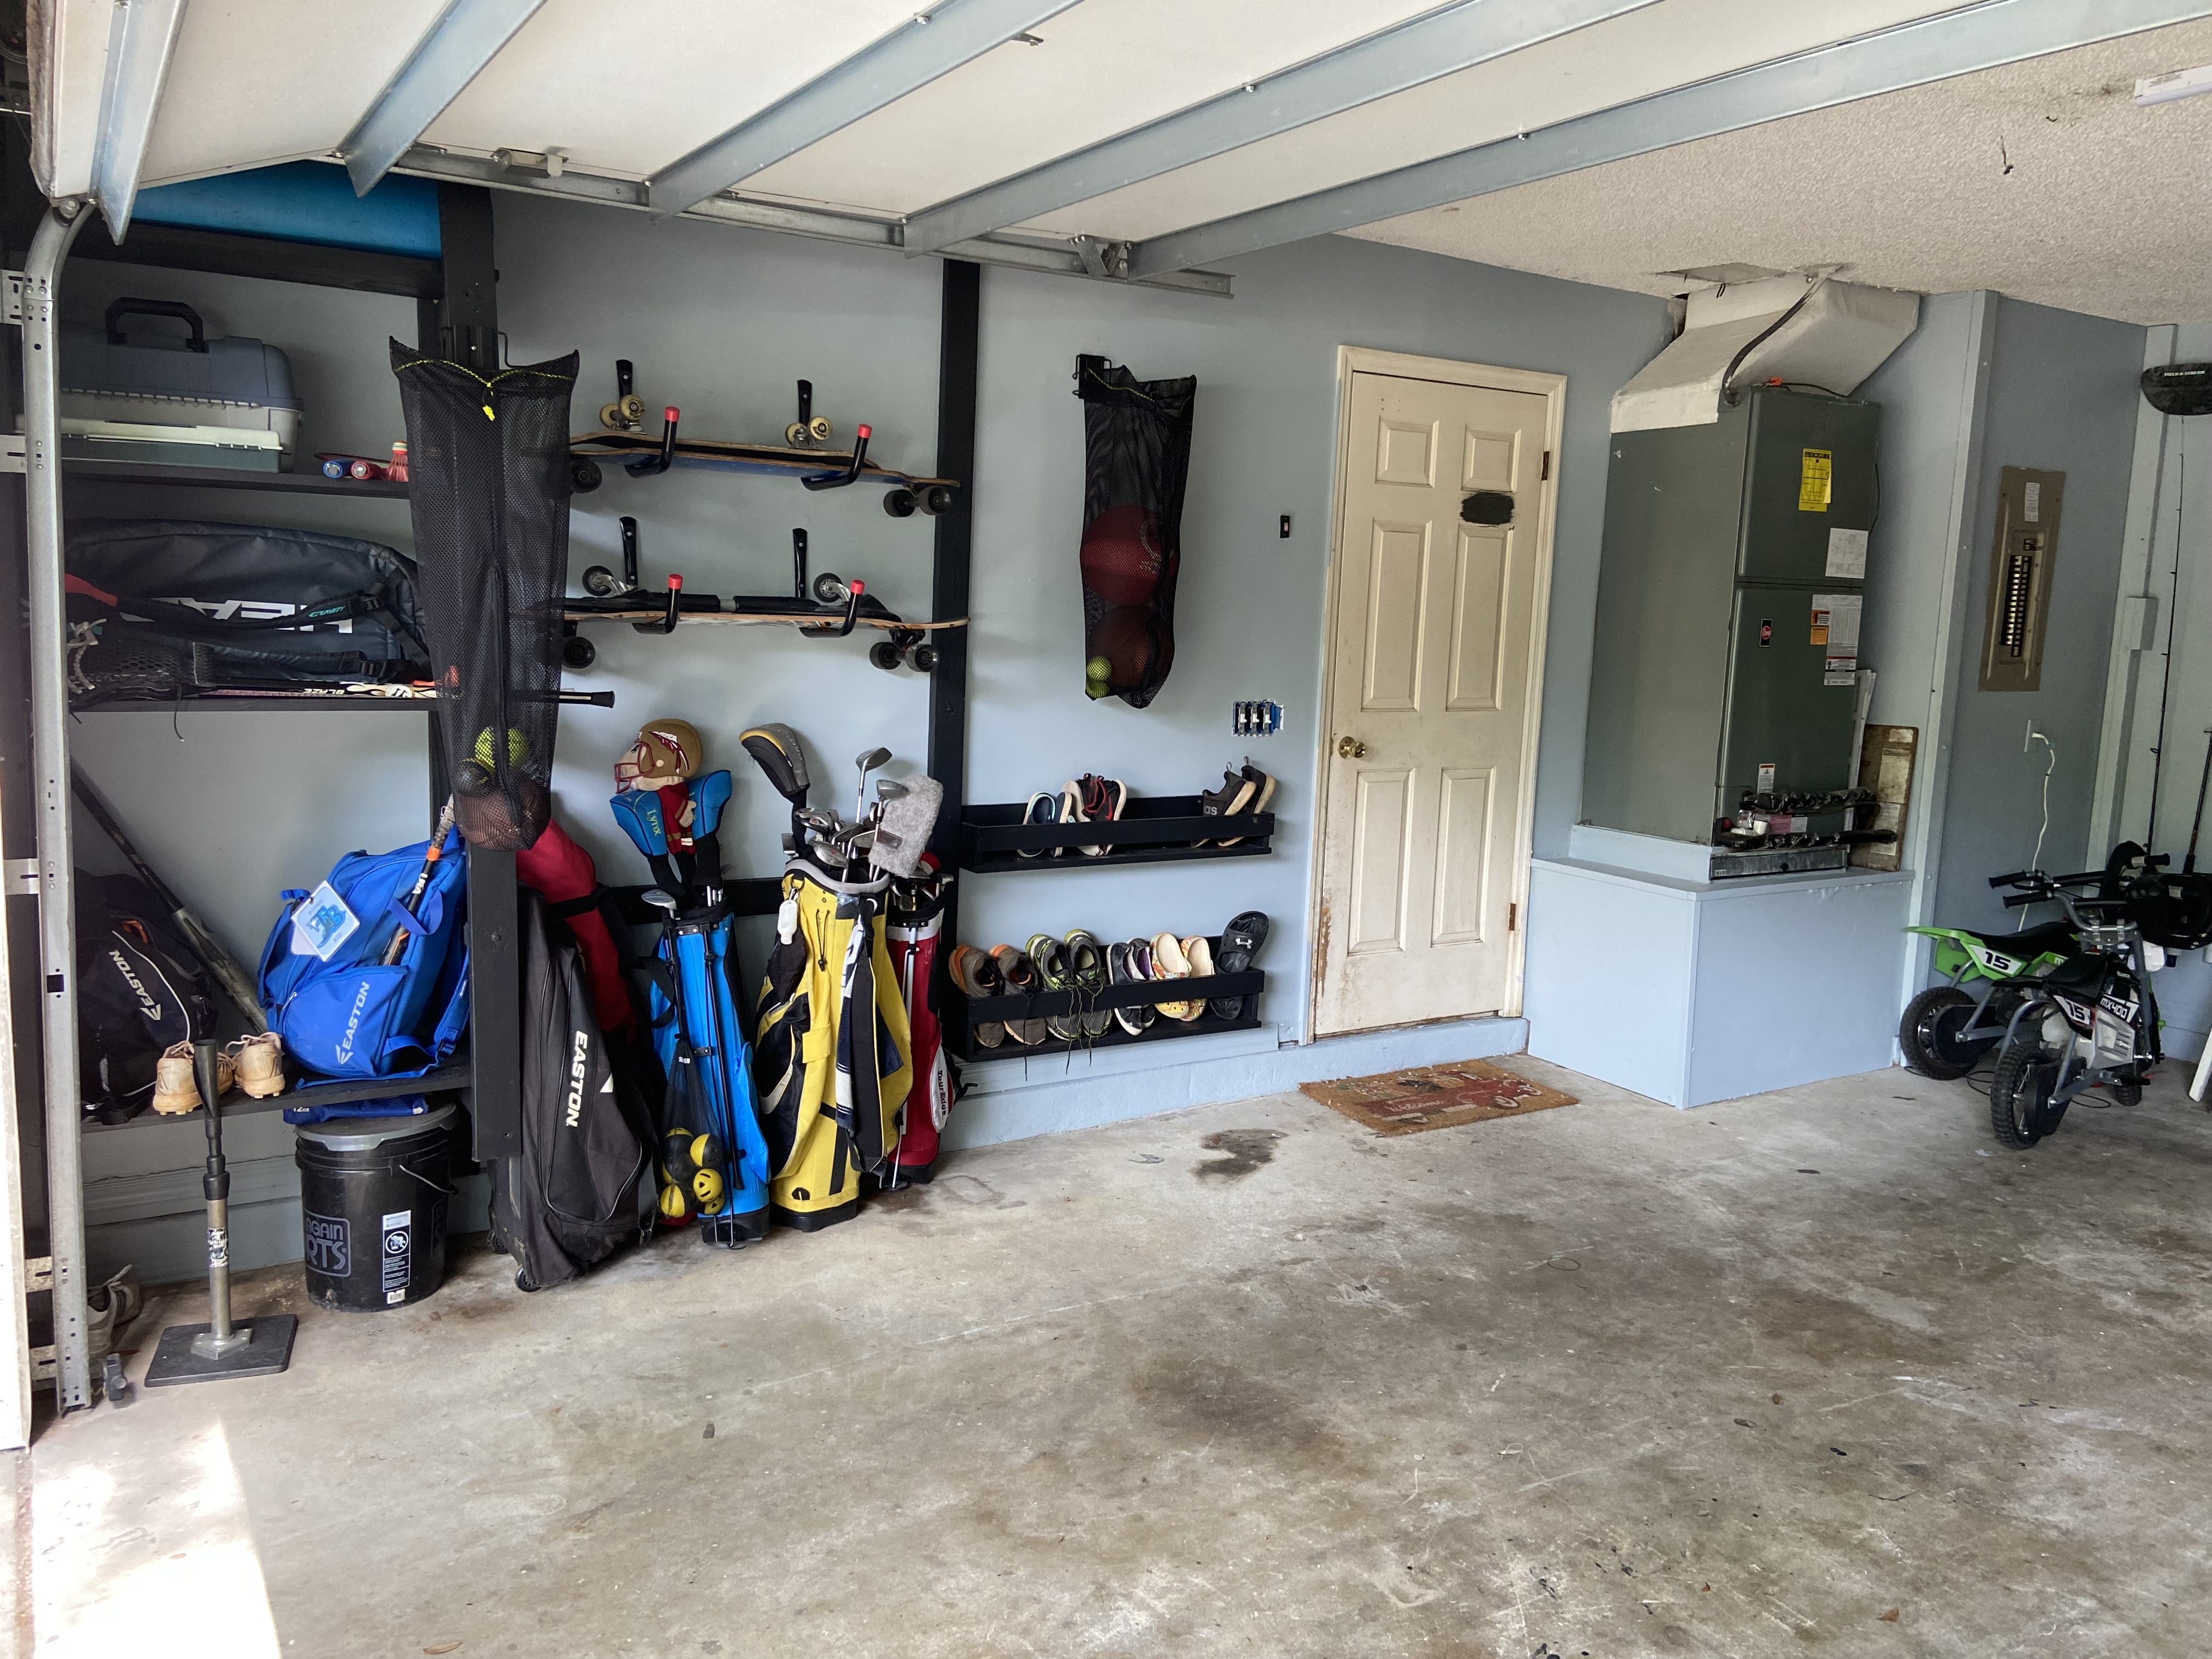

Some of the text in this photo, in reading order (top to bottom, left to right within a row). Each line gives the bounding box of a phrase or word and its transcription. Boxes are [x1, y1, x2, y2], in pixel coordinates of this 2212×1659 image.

[646, 808, 662, 837] Lynx
[109, 949, 155, 1007] EASTON
[1985, 951, 2011, 970] 15
[342, 981, 370, 1051] EASTON
[2066, 1000, 2085, 1021] 15
[566, 1030, 588, 1128] EASTON
